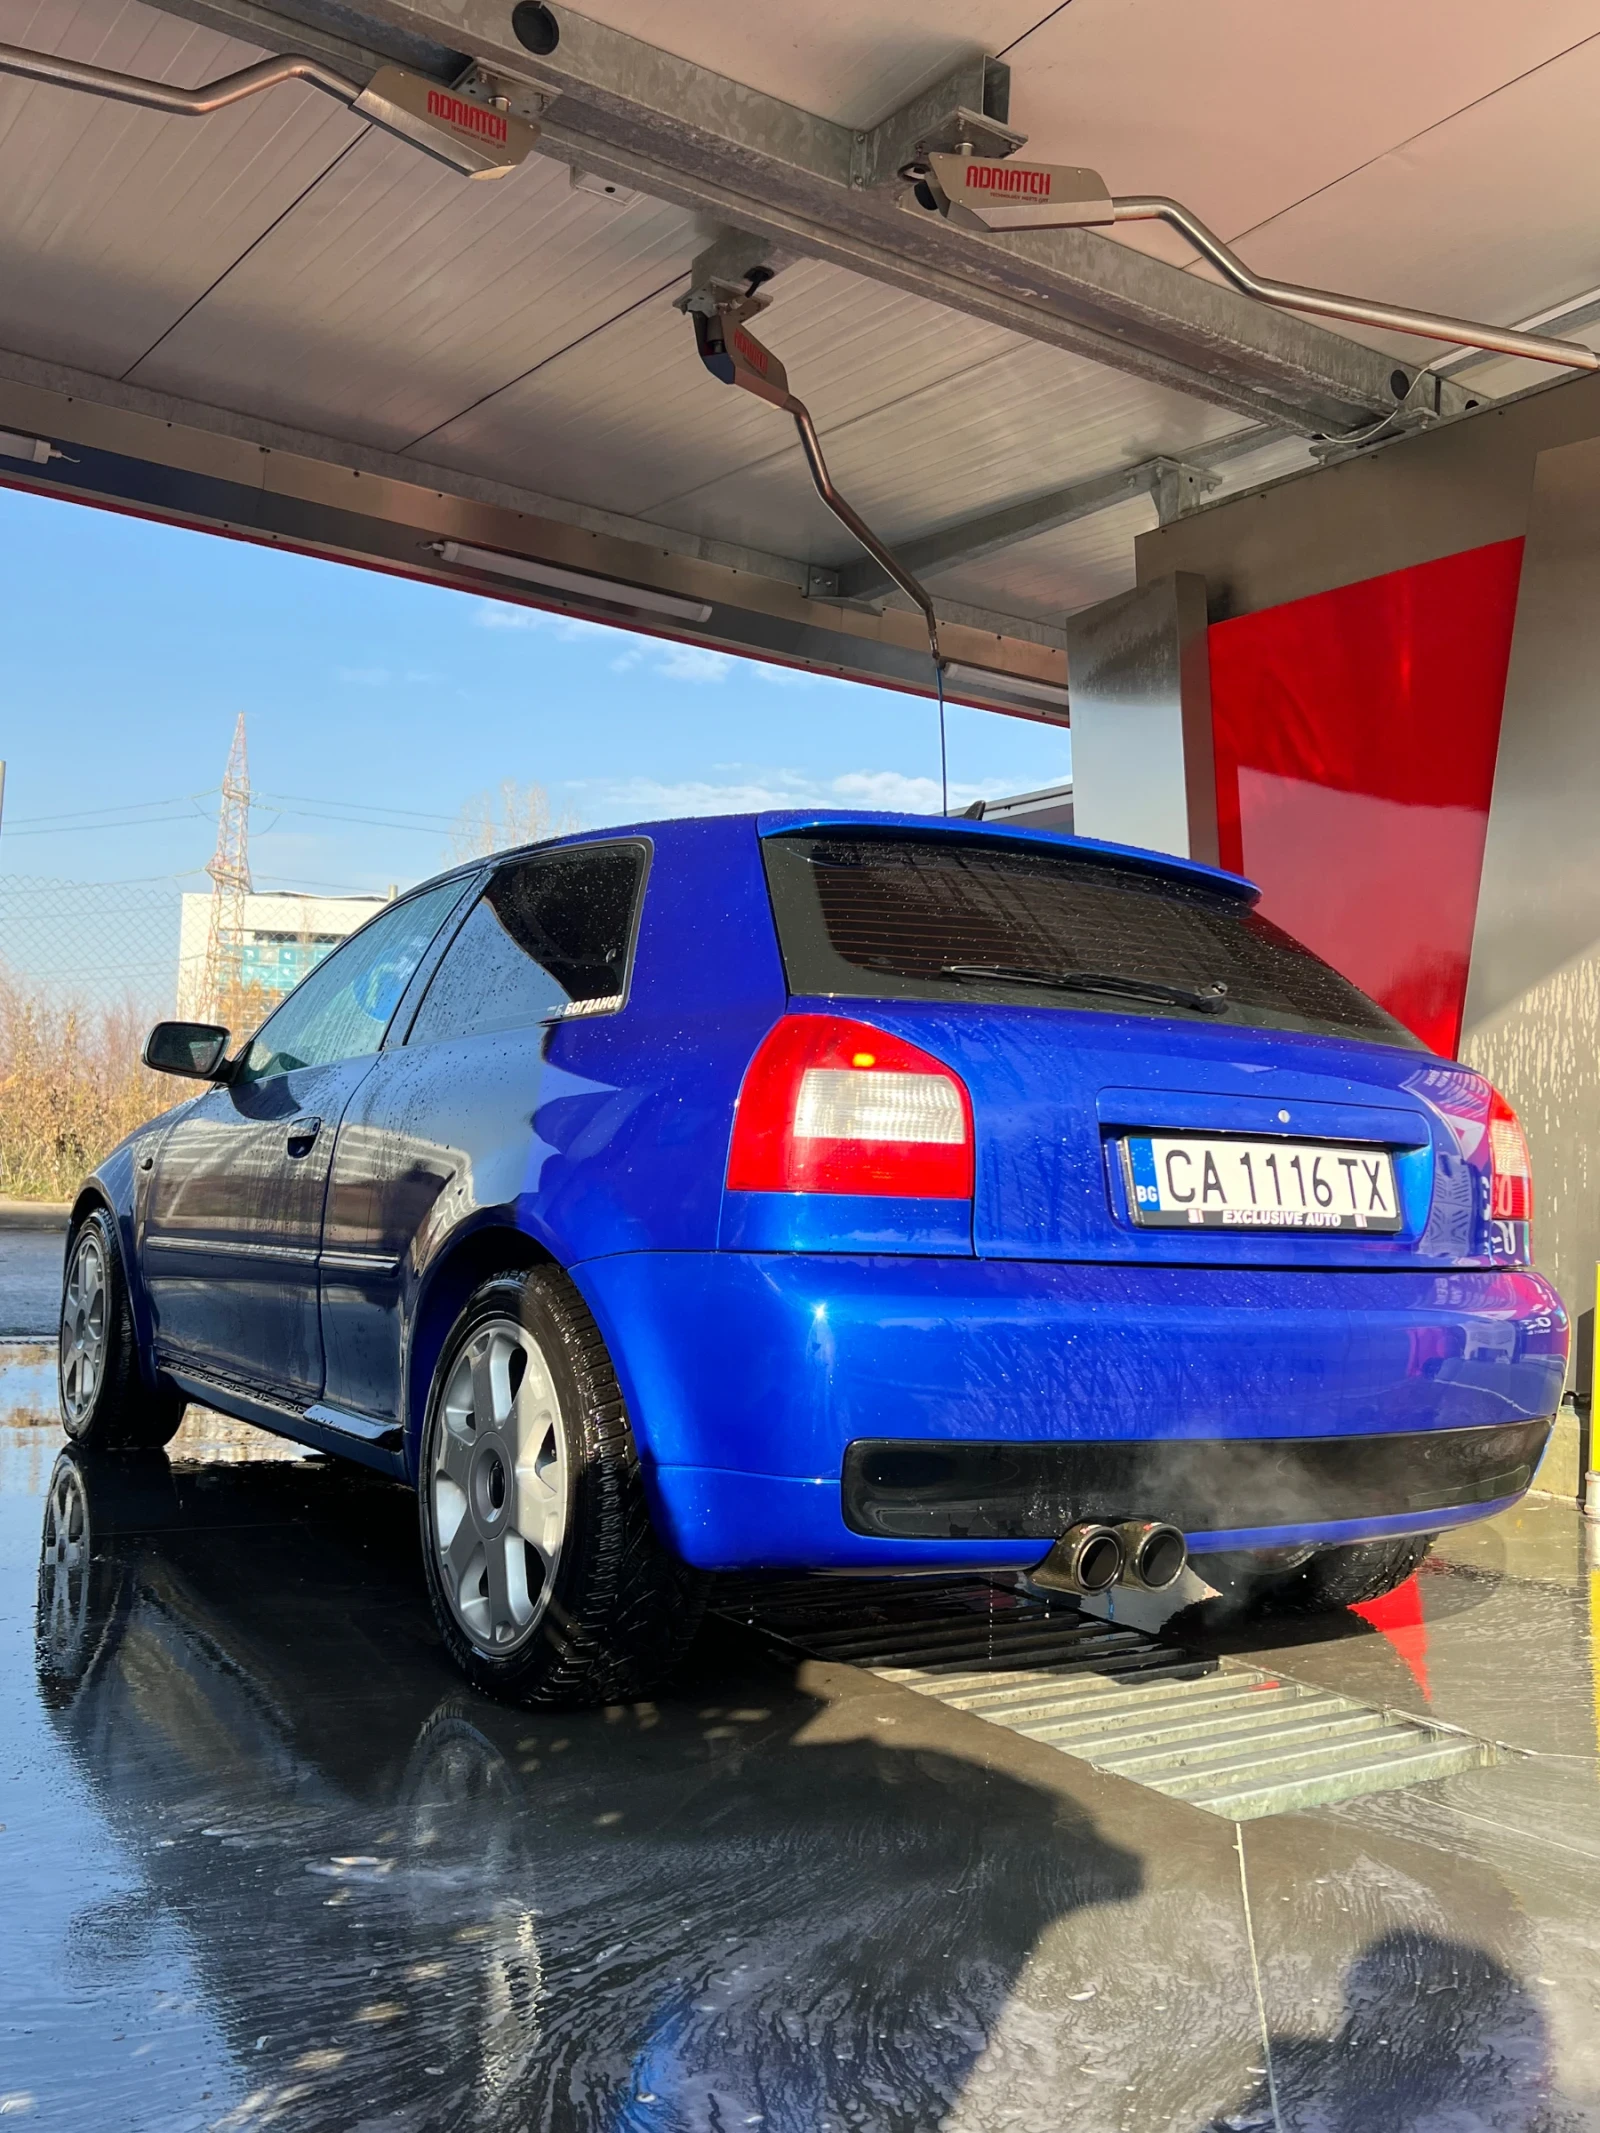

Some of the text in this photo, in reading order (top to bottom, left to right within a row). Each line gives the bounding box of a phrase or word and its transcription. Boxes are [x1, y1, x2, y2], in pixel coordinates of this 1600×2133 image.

[966, 165, 1051, 195] ADRIATCH
[1166, 1149, 1387, 1211] CA 1116 TX
[1136, 1186, 1158, 1202] BG
[1222, 1210, 1342, 1227] EXCLUSIVE AUTO
